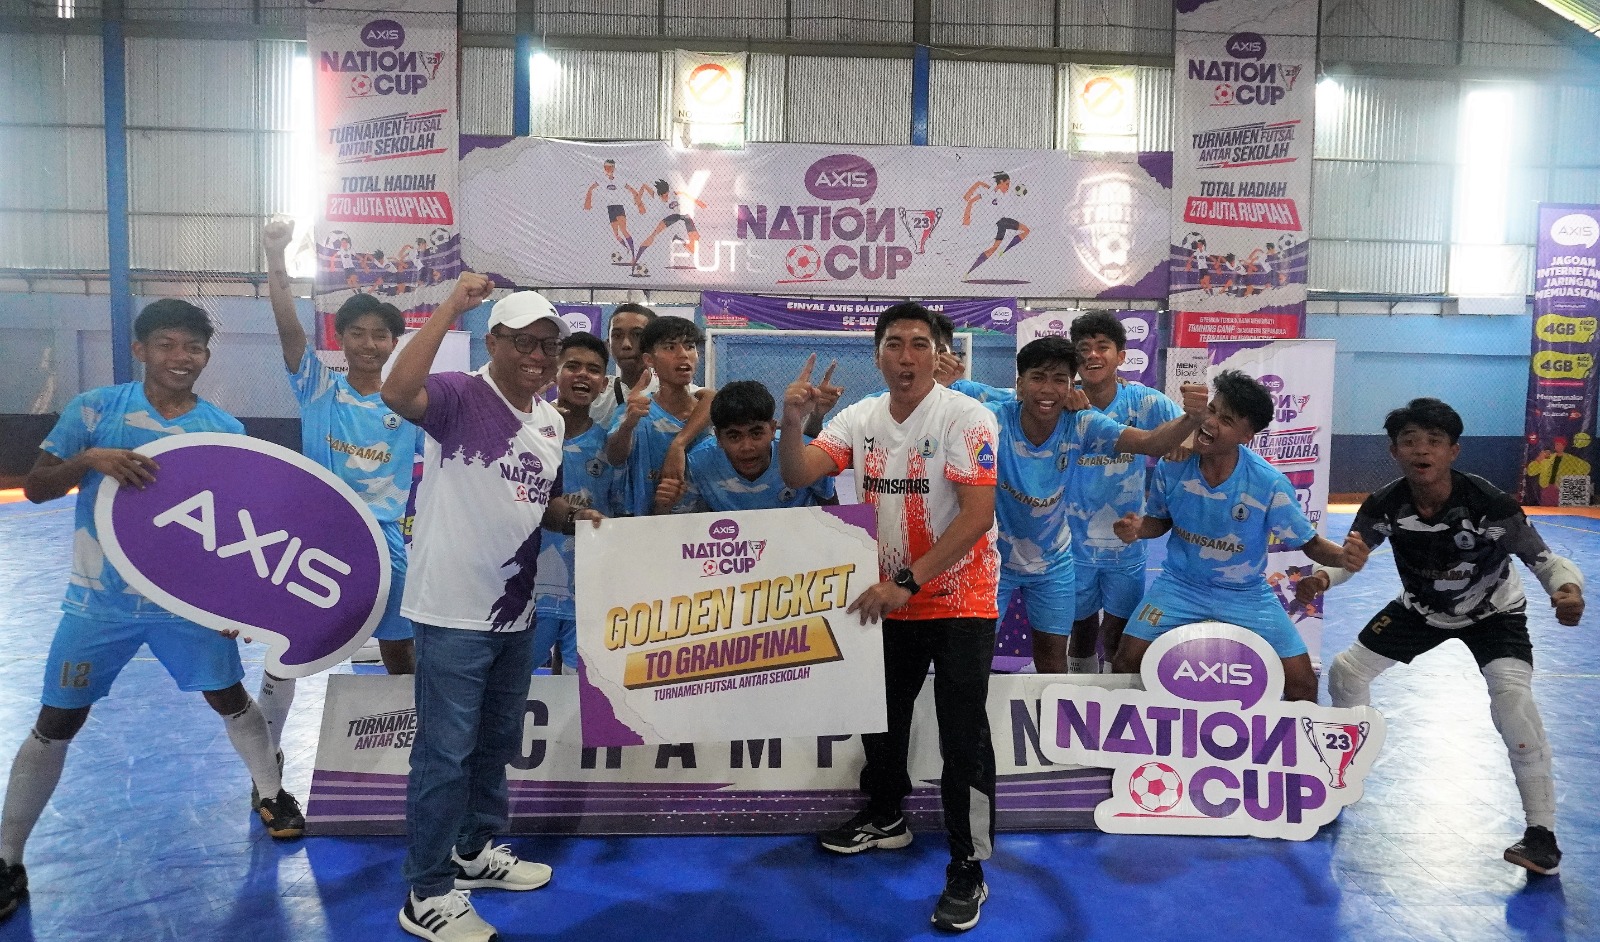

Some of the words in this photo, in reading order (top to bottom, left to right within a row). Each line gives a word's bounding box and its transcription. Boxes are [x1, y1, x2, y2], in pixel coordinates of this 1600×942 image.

[366, 29, 399, 40] AXIS
[1231, 42, 1262, 52] AXIS
[320, 50, 417, 72] NATION
[1188, 59, 1277, 84] NATION
[373, 74, 428, 95] CUP
[1235, 84, 1286, 105] CUP
[328, 120, 402, 144] TURNAMEN
[402, 117, 442, 134] FUTSAL
[1192, 129, 1261, 149] TURNAMEN
[1259, 129, 1295, 144] FUTSAL
[338, 140, 374, 157] ANTAR
[374, 132, 436, 156] SEKOLAH
[1199, 148, 1233, 162] ANTAR
[1231, 142, 1291, 162] SEKOLAH
[341, 175, 382, 192] TOTAL
[383, 173, 437, 191] HADIAH
[814, 170, 869, 188] AXIS
[1200, 181, 1237, 197] TOTAL
[1237, 181, 1288, 197] HADIAH
[329, 197, 352, 216] 270
[352, 198, 385, 217] JUTA
[384, 196, 448, 219] RUPIAH
[1189, 200, 1208, 218] 270
[1208, 201, 1238, 221] JUTA
[1238, 202, 1295, 225] RUPIAH
[736, 203, 897, 243] NATION
[1558, 225, 1593, 237] AXIS
[823, 244, 913, 280] CUP
[1551, 255, 1597, 268] JAGOAN
[1543, 276, 1598, 289] JARINGAN
[786, 302, 826, 311] SINYAL
[828, 304, 854, 312] AXIS
[569, 320, 587, 328] XIS
[1126, 325, 1145, 334] XIS
[1217, 325, 1236, 333] CAMP
[1544, 322, 1576, 336] 4GB
[1125, 357, 1144, 365] XIS
[1540, 359, 1573, 373] 4GB
[1275, 409, 1298, 423] UP
[1277, 443, 1319, 460] JUARA
[520, 457, 541, 469] AXIS
[712, 525, 736, 535] AXIS
[153, 489, 352, 609] AXIS
[682, 540, 748, 560] NATION
[719, 557, 756, 575] CUP
[603, 583, 736, 652] GOLDEN
[739, 563, 856, 627] TICKET
[645, 650, 672, 681] TO
[675, 624, 811, 675] GRANDFINAL
[59, 660, 92, 690] 12
[1173, 659, 1253, 687] AXIS
[654, 684, 704, 701] TURNAMEN
[703, 679, 738, 694] FUTSAL
[738, 673, 769, 689] ANTAR
[769, 666, 811, 684] SEKOLAH
[347, 713, 418, 738] TURNAME
[1056, 698, 1297, 768] NATION
[354, 732, 395, 751] ANTAR
[1188, 765, 1327, 824] CUP
